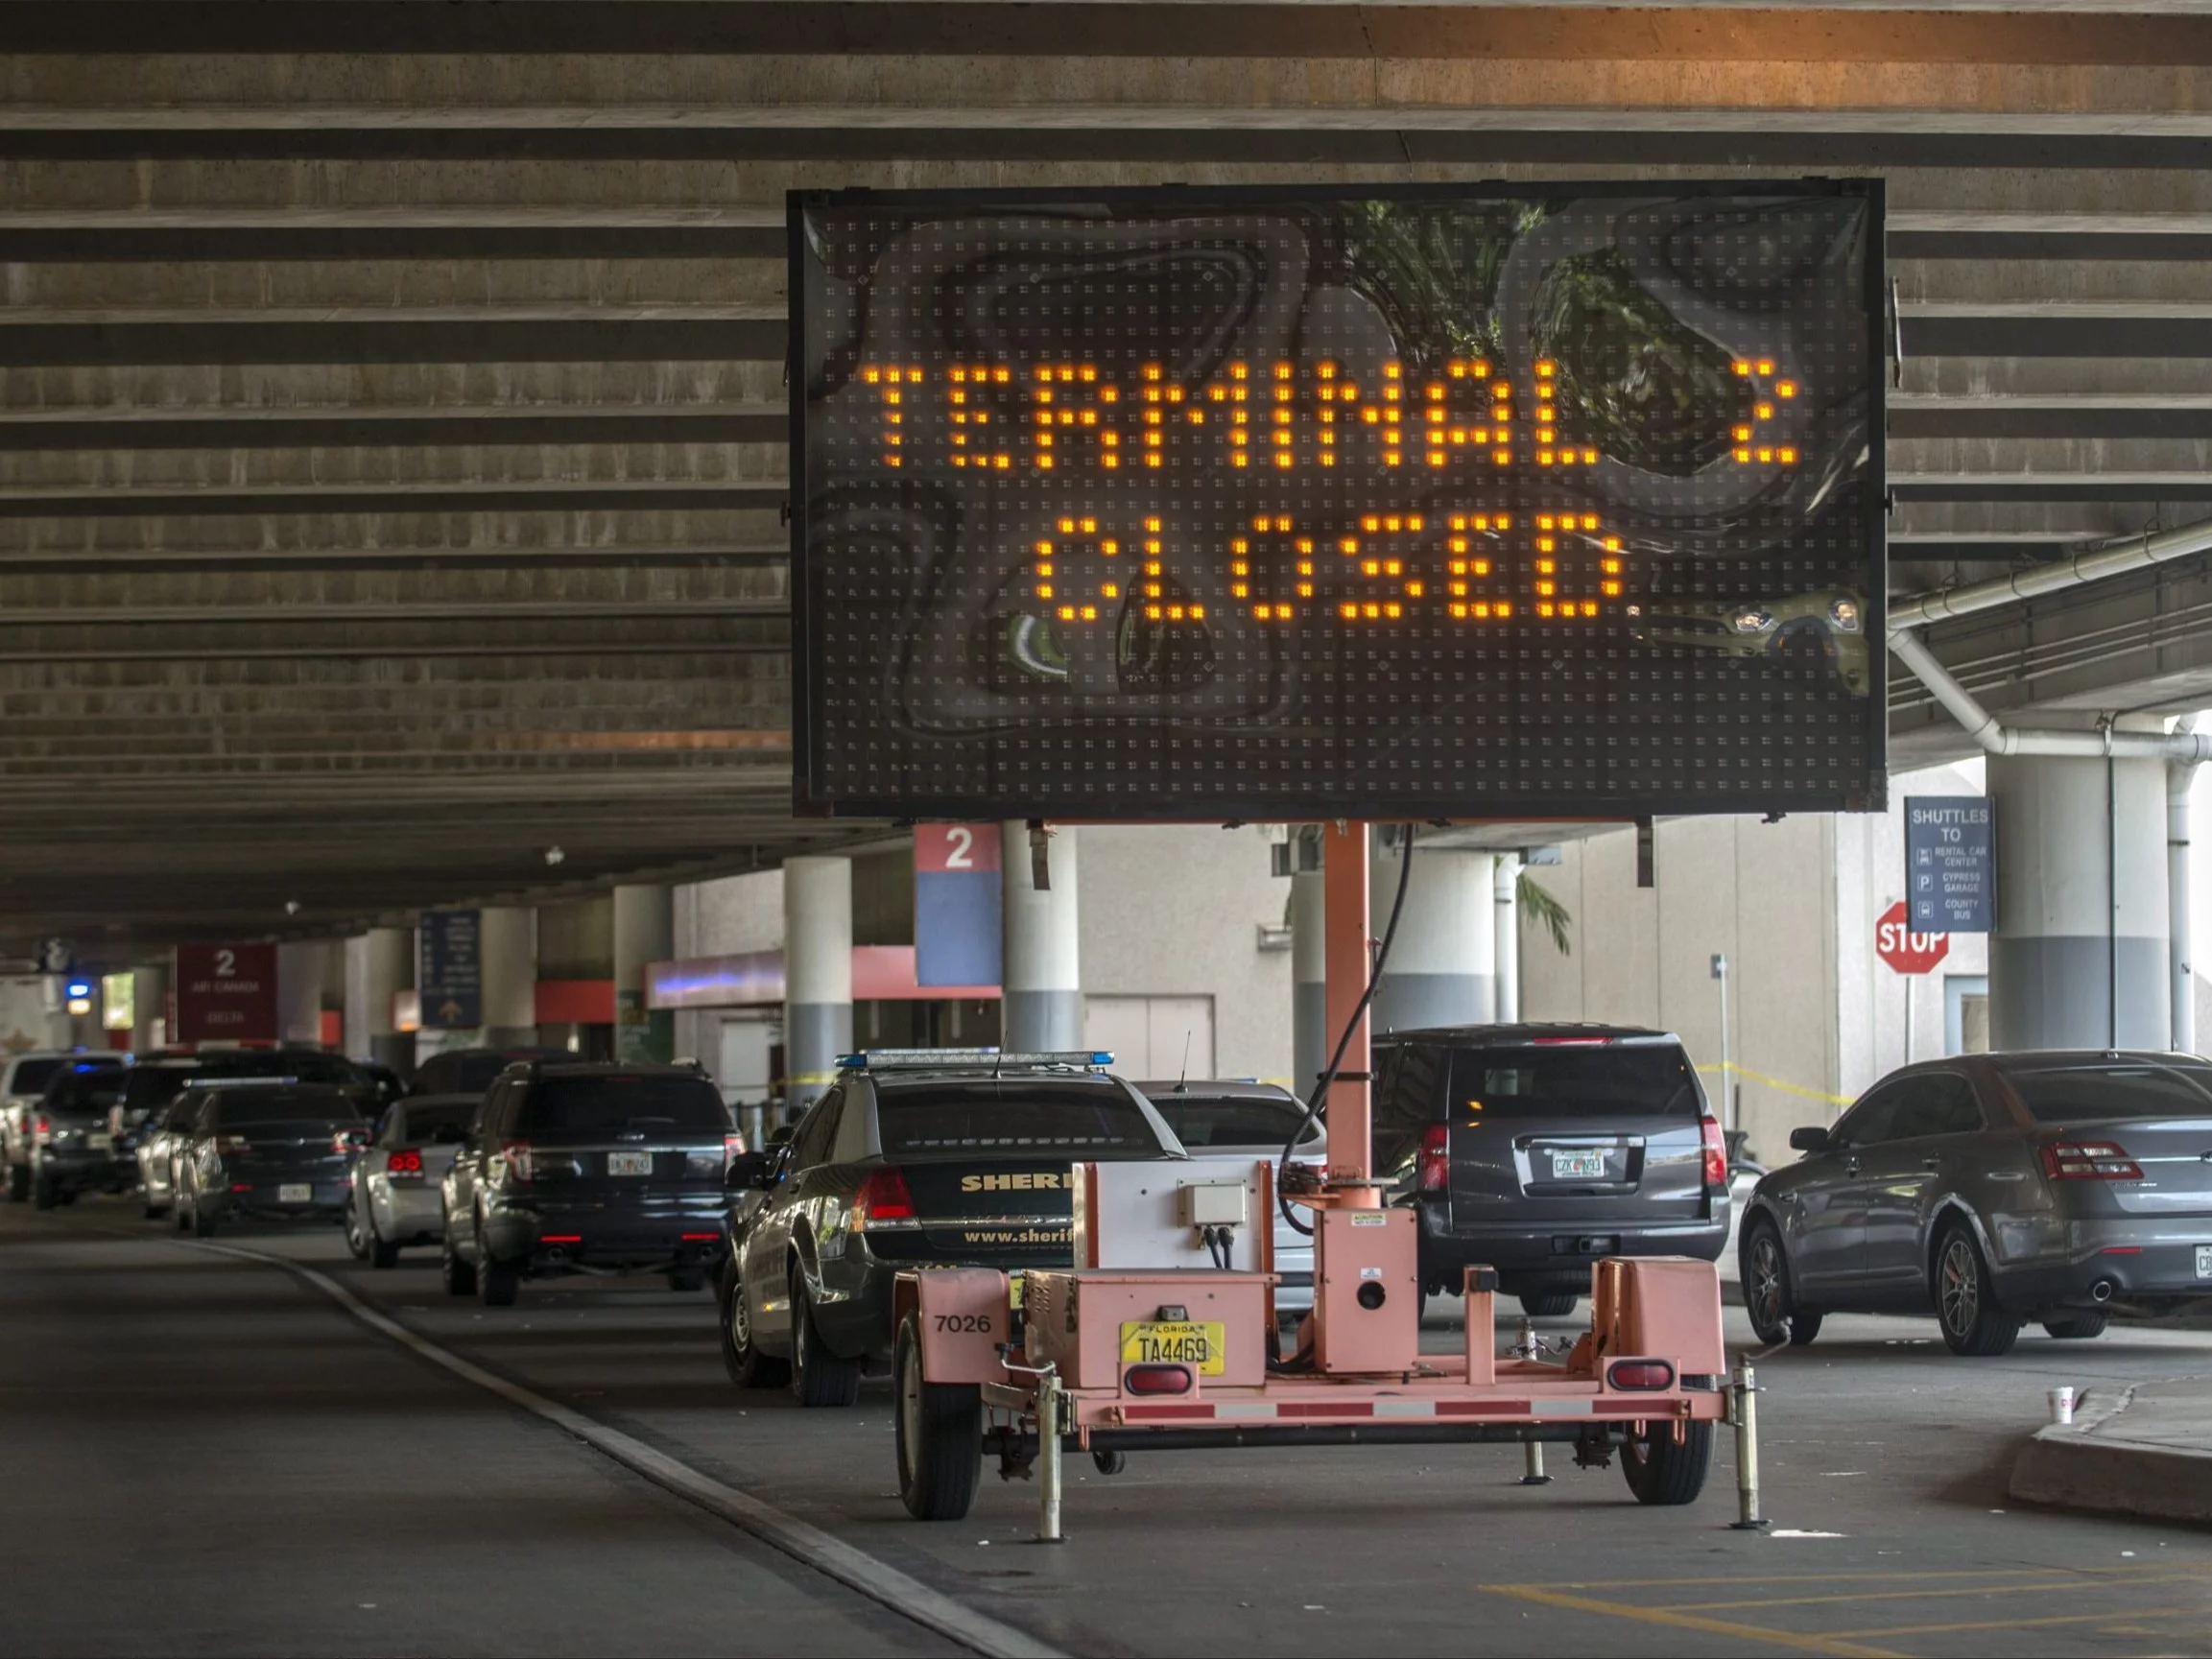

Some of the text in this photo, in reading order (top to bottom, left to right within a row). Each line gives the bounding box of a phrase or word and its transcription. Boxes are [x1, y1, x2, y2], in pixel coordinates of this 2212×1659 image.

[861, 358, 1798, 469] TERMINAL 2
[1036, 512, 1622, 622] CLOSED
[1913, 809, 1988, 823] SHUTTLES
[1940, 827, 1962, 841] TO
[945, 826, 973, 867] 2
[1935, 846, 1986, 856] RENTAL CAR
[1944, 857, 1977, 866] CENTER
[1942, 872, 1981, 882] CYPRESS
[1944, 883, 1979, 893] GARAGE
[1944, 898, 1978, 909] COUNTY
[1954, 910, 1971, 920] BUS
[1879, 922, 1946, 953] STOP
[216, 949, 236, 976] 2
[934, 1315, 991, 1333] 7026
[1149, 1324, 1196, 1333] FLORIDA
[1138, 1338, 1207, 1363] TA4469
